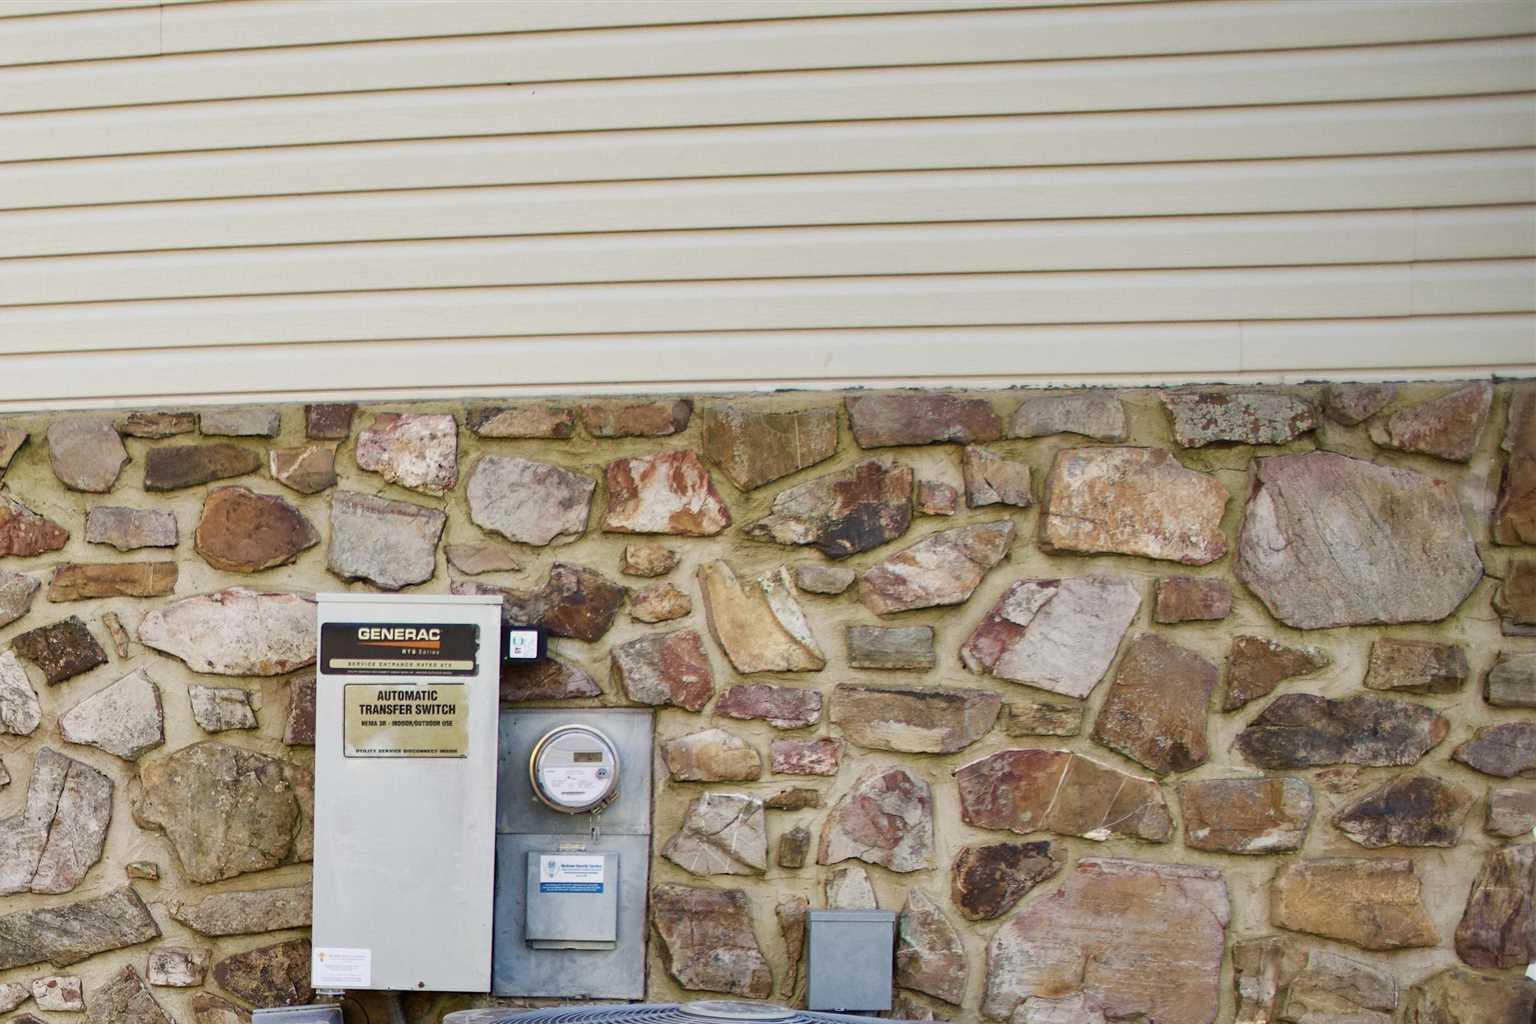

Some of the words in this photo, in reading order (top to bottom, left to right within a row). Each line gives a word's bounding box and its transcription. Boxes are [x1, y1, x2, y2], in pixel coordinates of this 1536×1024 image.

[358, 628, 440, 641] GENERAC
[377, 690, 438, 701] AUTOMATIC
[359, 704, 413, 715] TRANSFER
[415, 704, 456, 715] SWITCH
